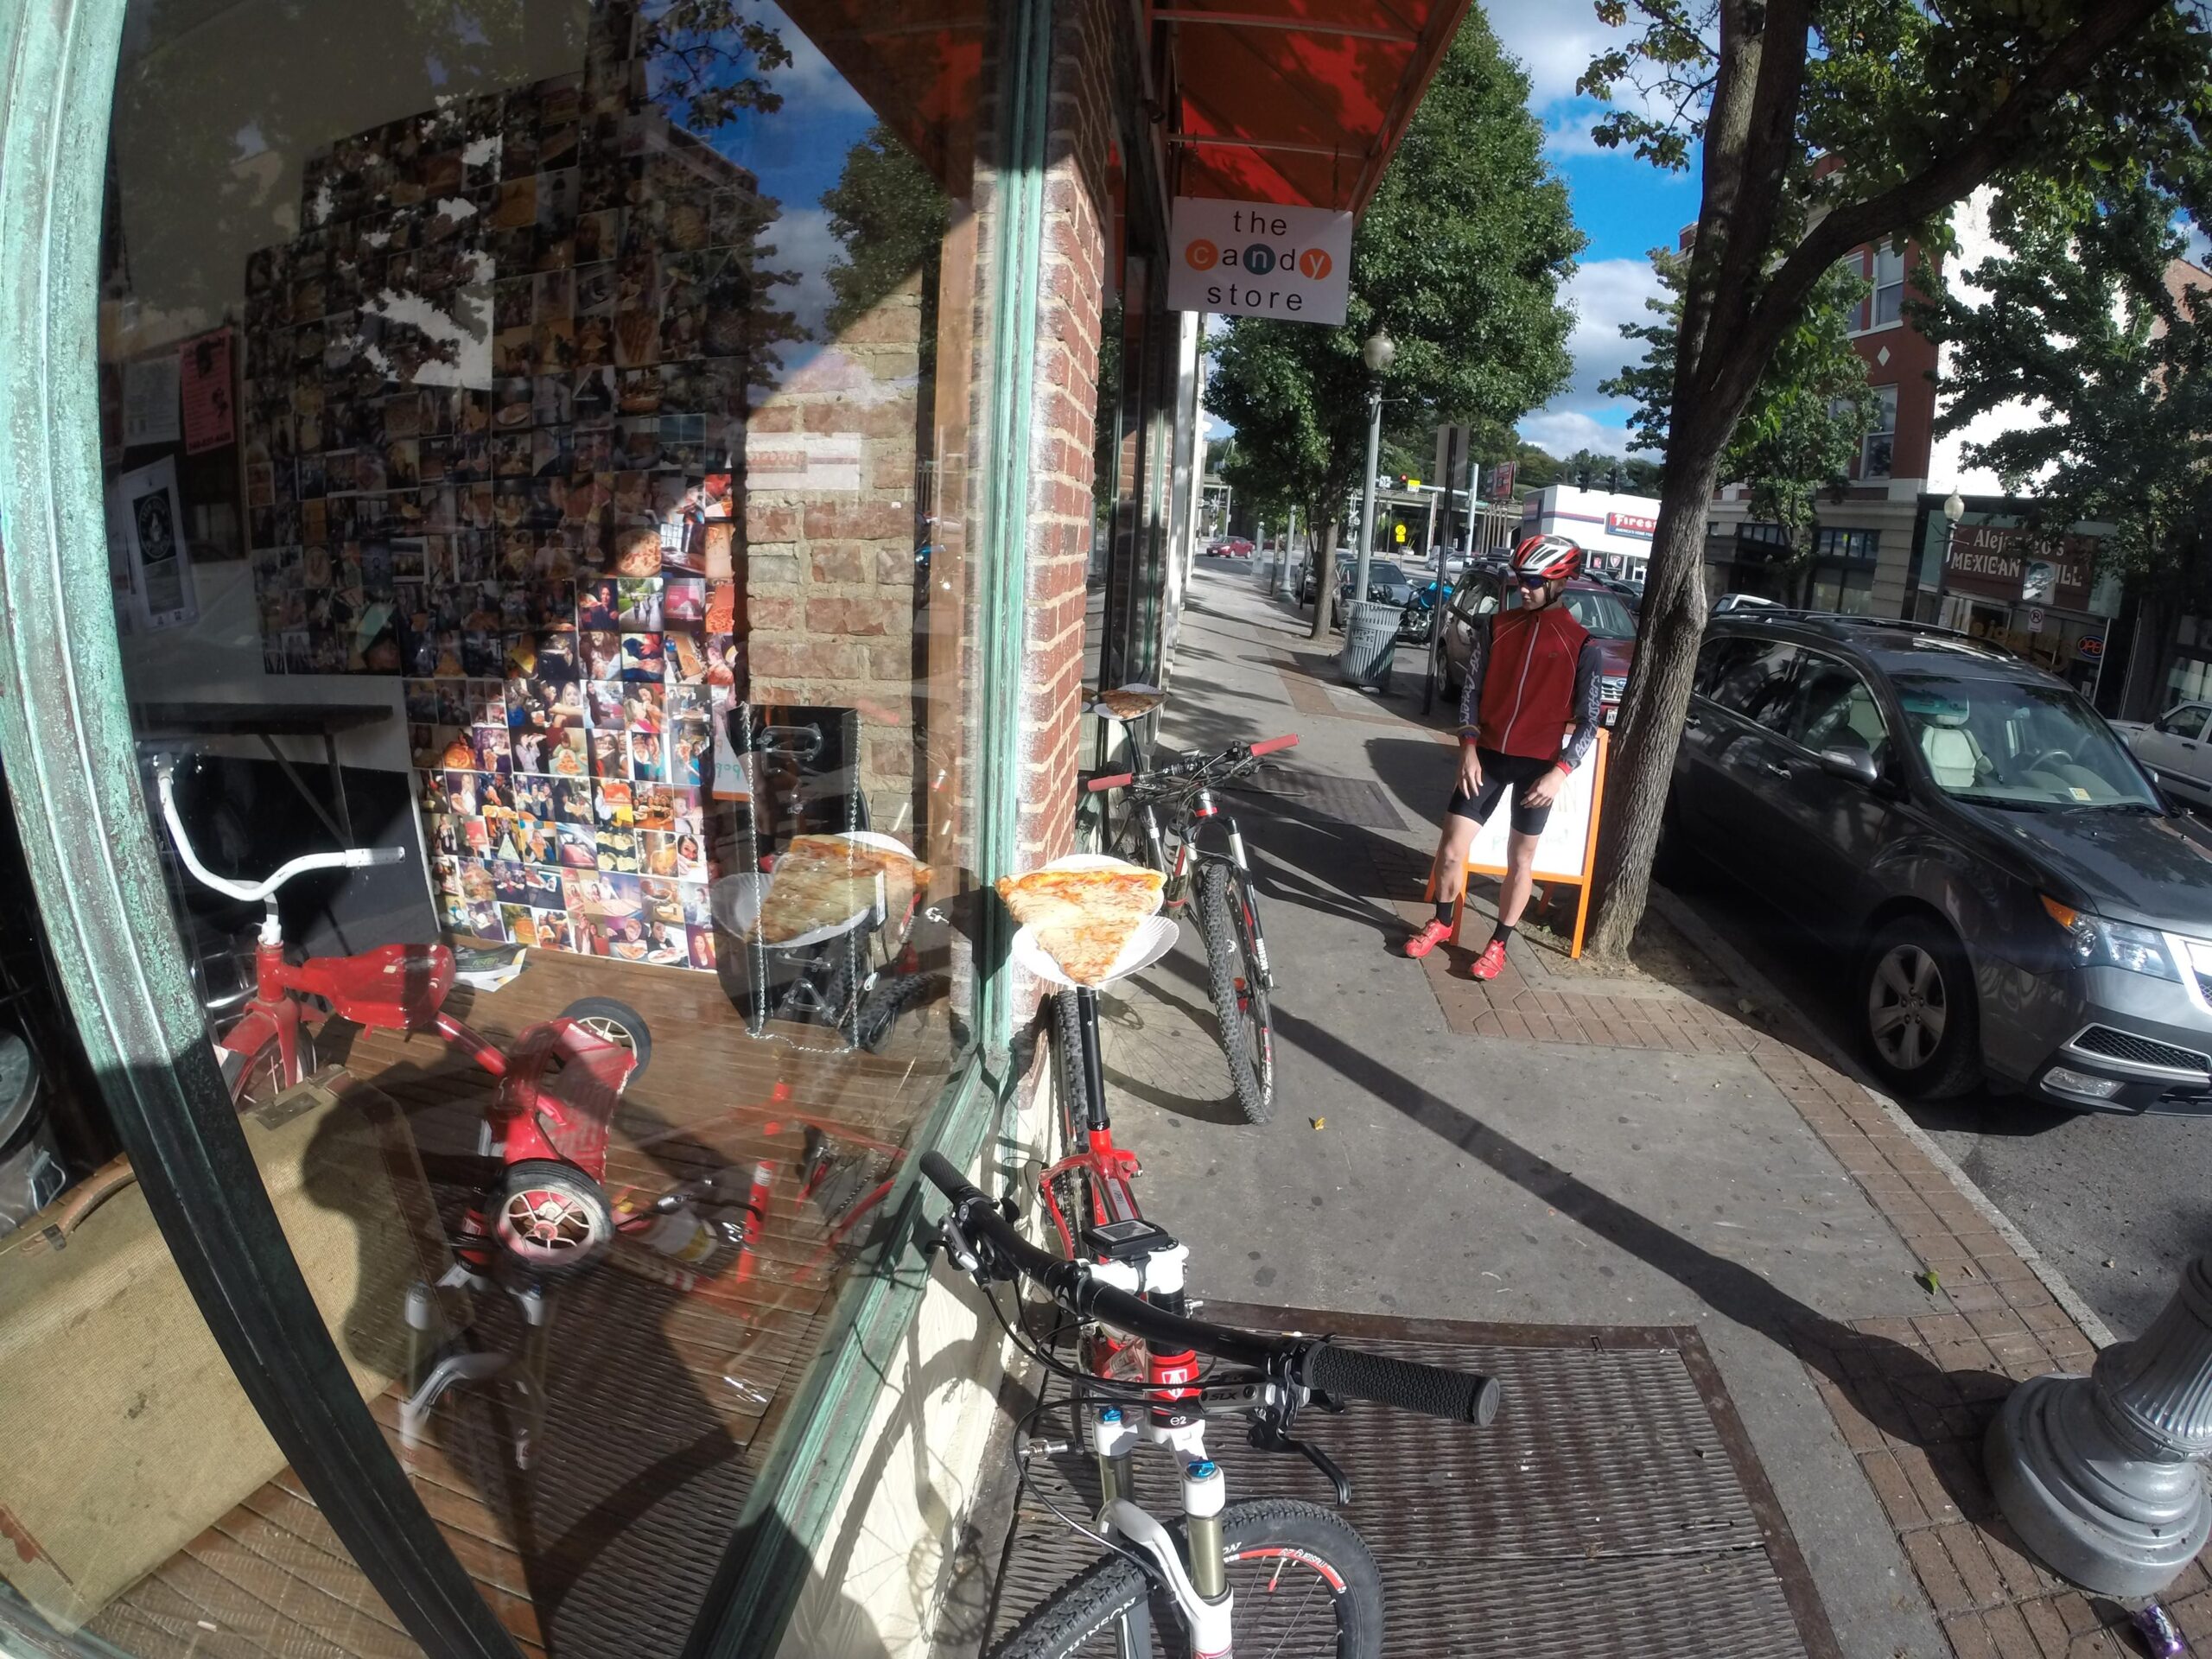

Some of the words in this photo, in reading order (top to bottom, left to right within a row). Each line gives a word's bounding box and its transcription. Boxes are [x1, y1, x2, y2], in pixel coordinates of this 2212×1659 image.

[1233, 210, 1287, 236] the
[1192, 245, 1326, 281] candy
[1207, 283, 1303, 311] store
[1614, 513, 1656, 529] Fires
[1950, 552, 2021, 577] MEXICAN
[2056, 563, 2082, 587] ILL
[1209, 1391, 1238, 1402] SLX
[1170, 1416, 1187, 1425] e2
